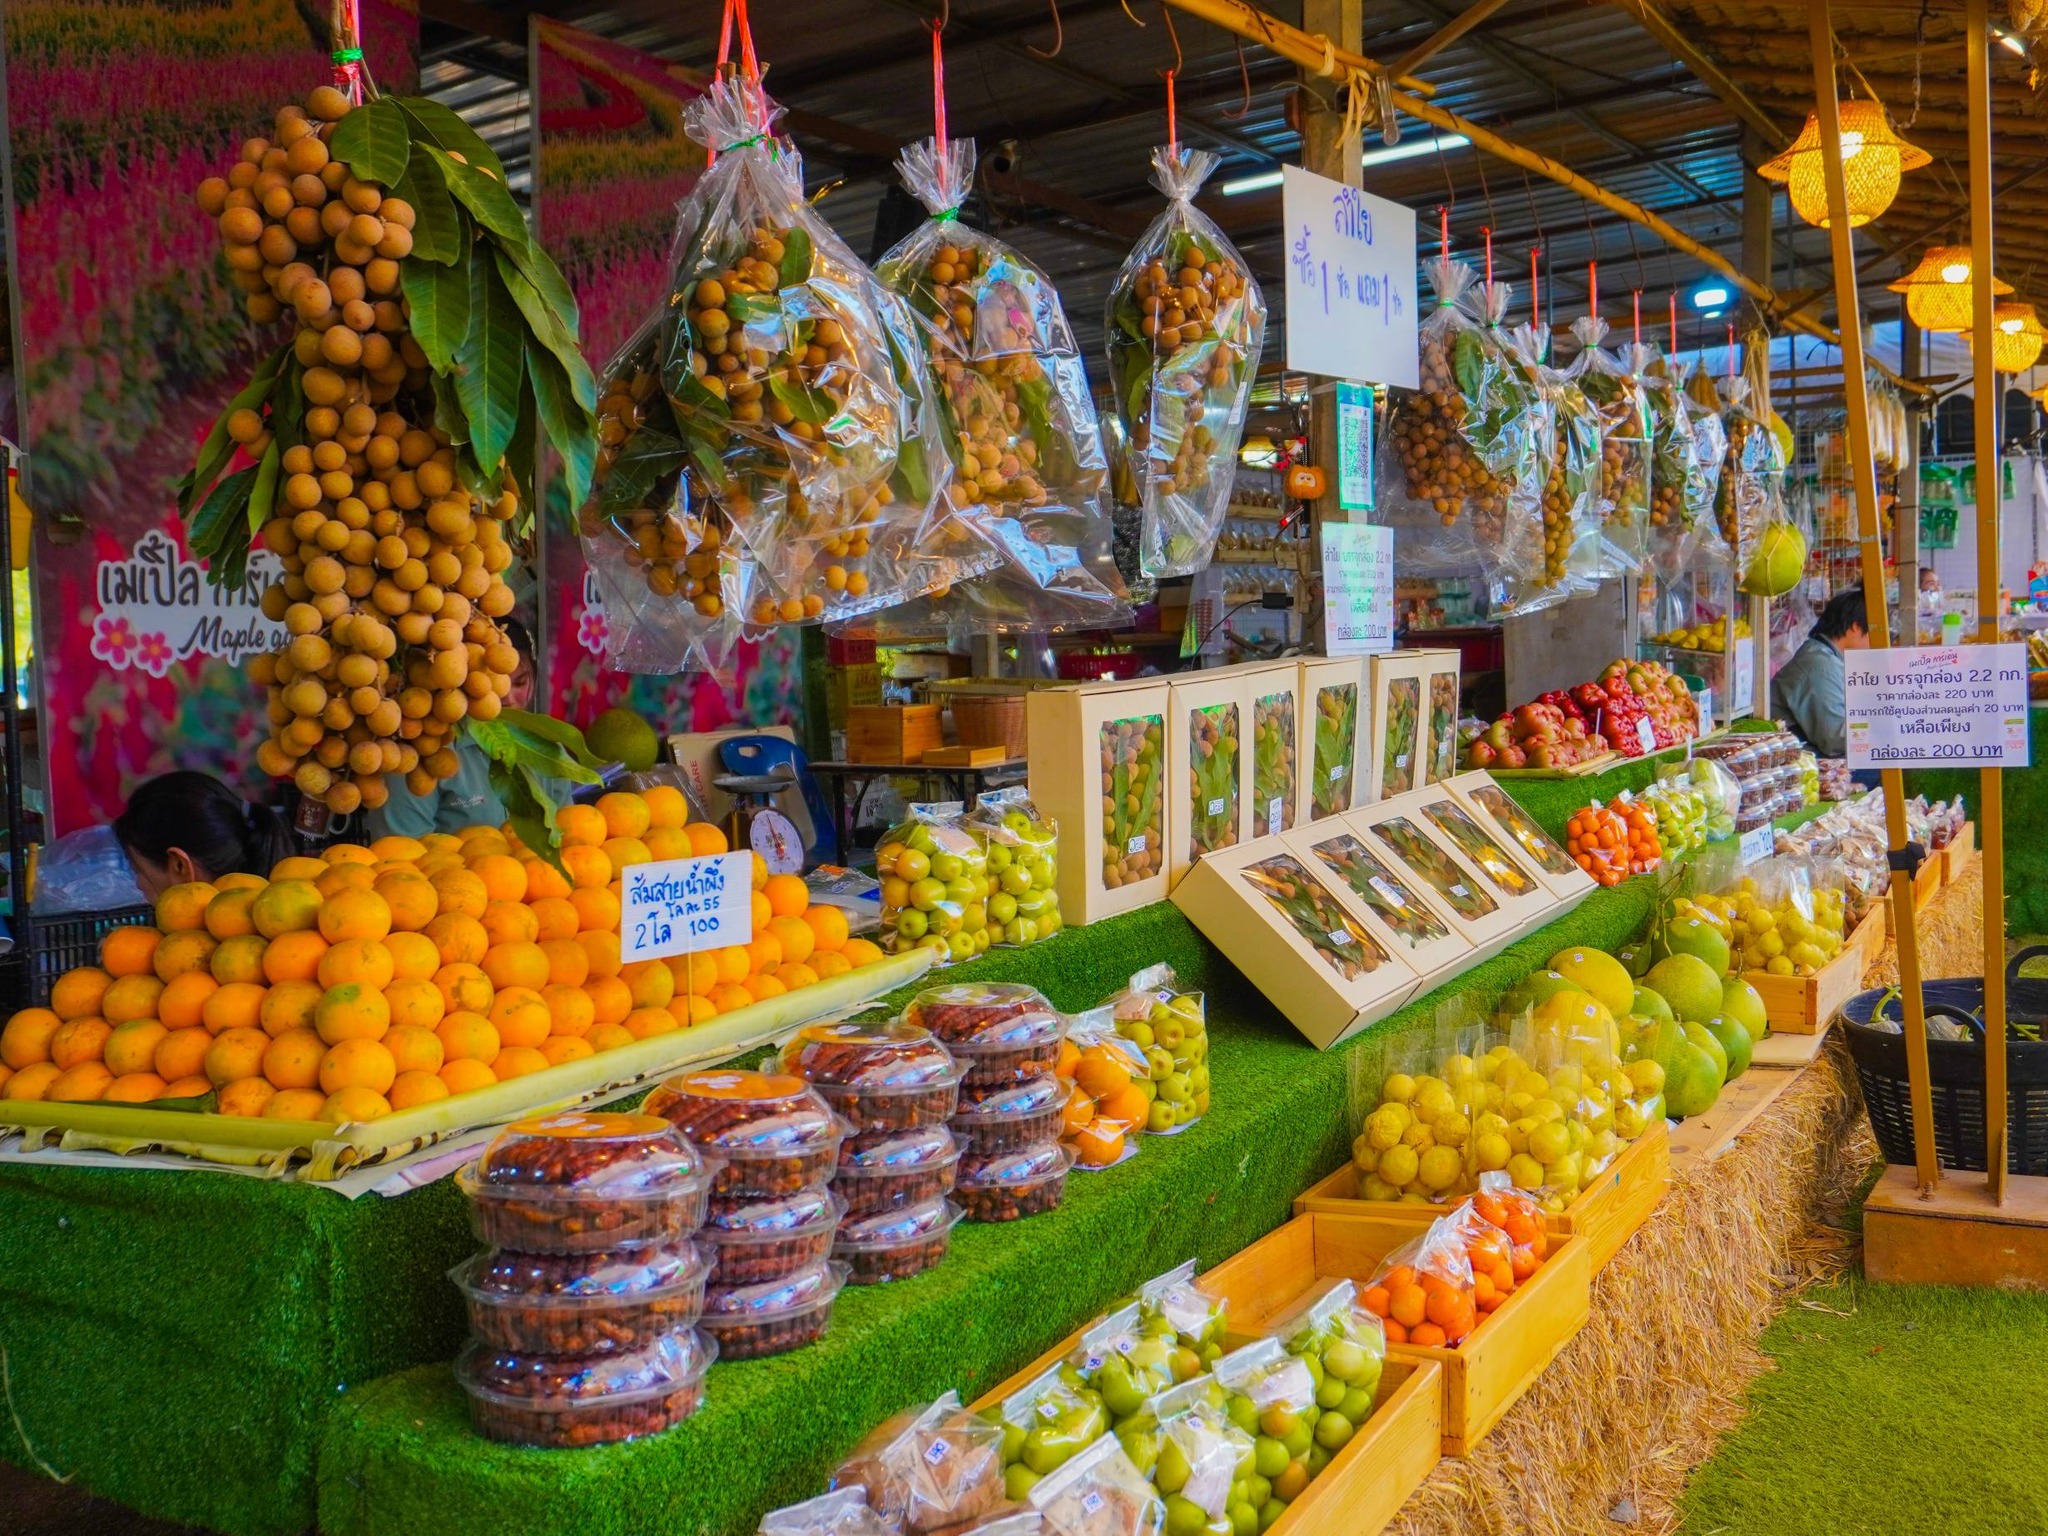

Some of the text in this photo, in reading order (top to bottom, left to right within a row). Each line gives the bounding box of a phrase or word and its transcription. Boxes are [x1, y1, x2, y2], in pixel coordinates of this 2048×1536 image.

[178, 614, 265, 661] Maple
[1848, 668, 2024, 689] ลำไย บรรจุกล่อง 2.2 กก.
[1876, 689, 1995, 702] ราคากล่องละ 220 บาท
[1849, 703, 2025, 719] สามารถใช้คูปองส่วนลดมูลค่า 20 บาท
[1900, 717, 1972, 735] เหลือเพียง
[1870, 743, 2004, 759] กล่องละ 200 บาท
[630, 857, 725, 905] ส้มสายน้ำผึ้ง
[703, 896, 720, 911] 55
[634, 911, 720, 950] 2 โล 100
